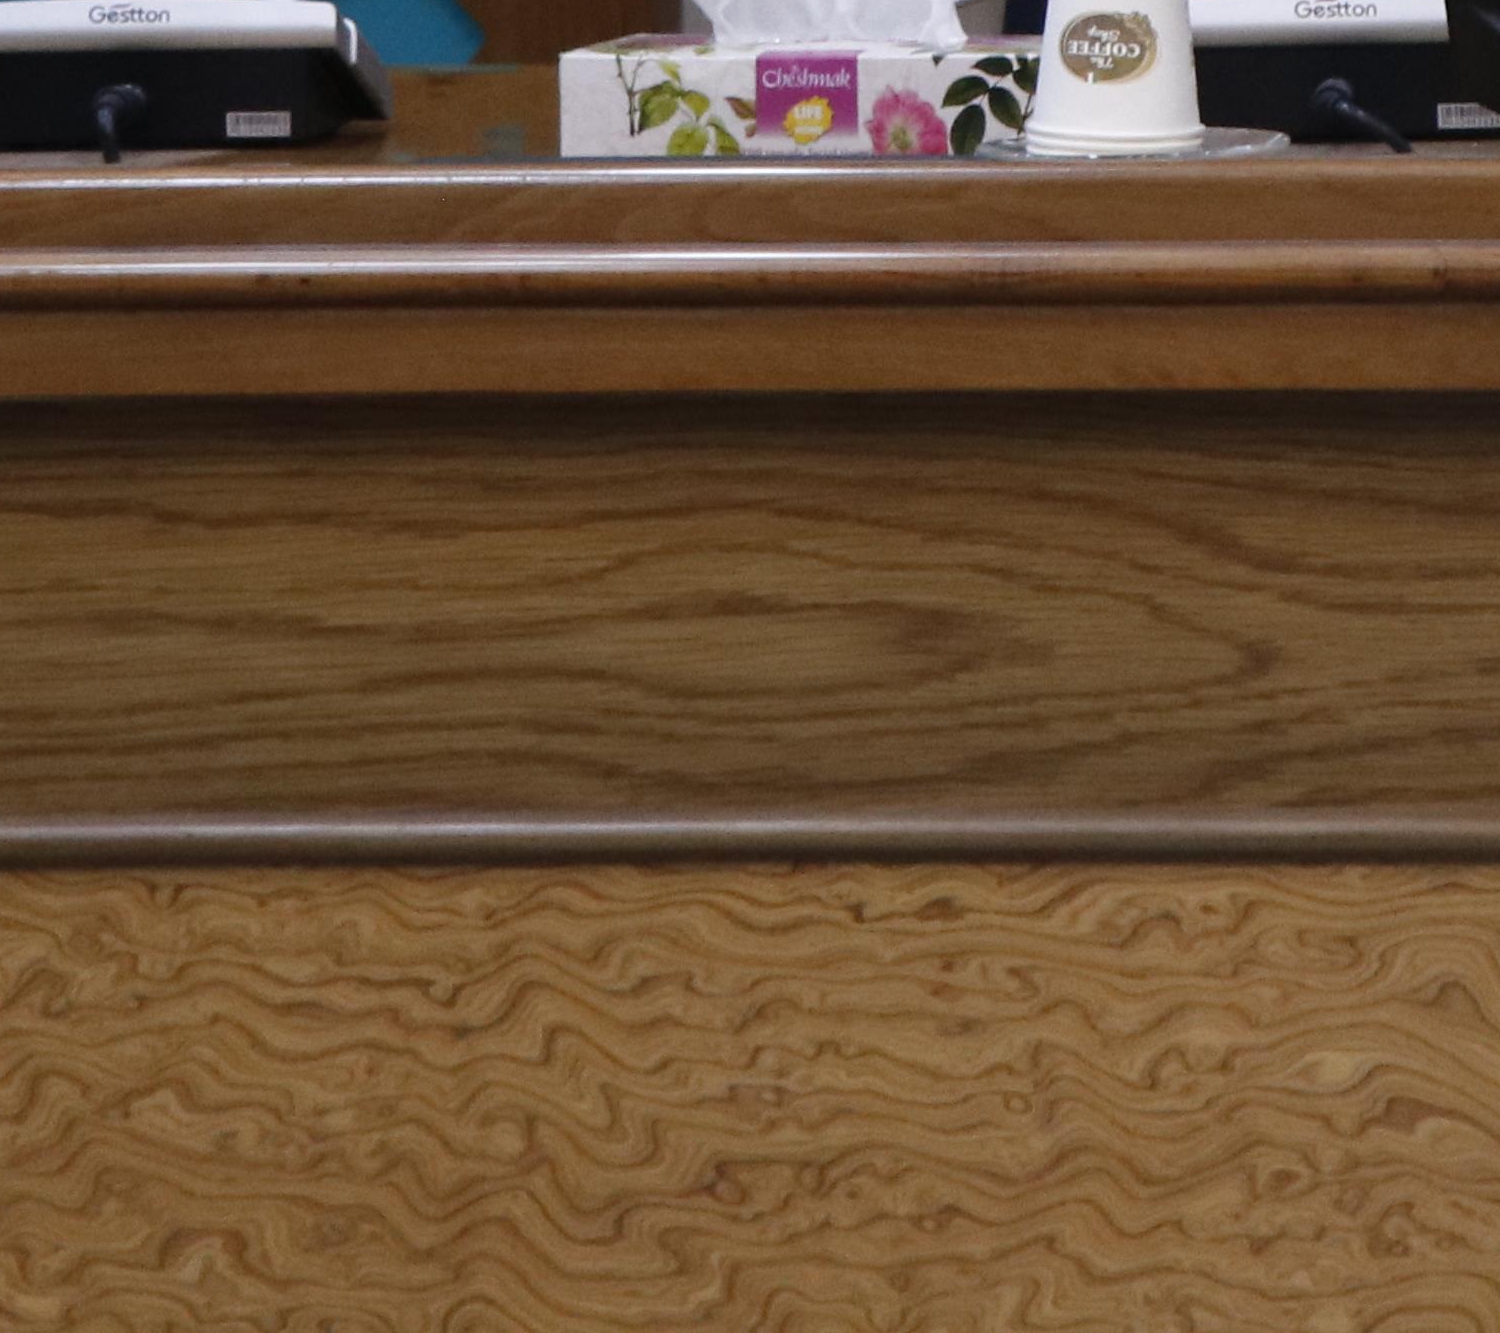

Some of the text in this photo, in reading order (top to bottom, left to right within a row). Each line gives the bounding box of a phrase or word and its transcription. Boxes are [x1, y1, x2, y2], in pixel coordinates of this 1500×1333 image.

[88, 4, 170, 24] Gestton
[1067, 39, 1141, 58] COFFEE
[762, 66, 851, 90] Cheshmak
